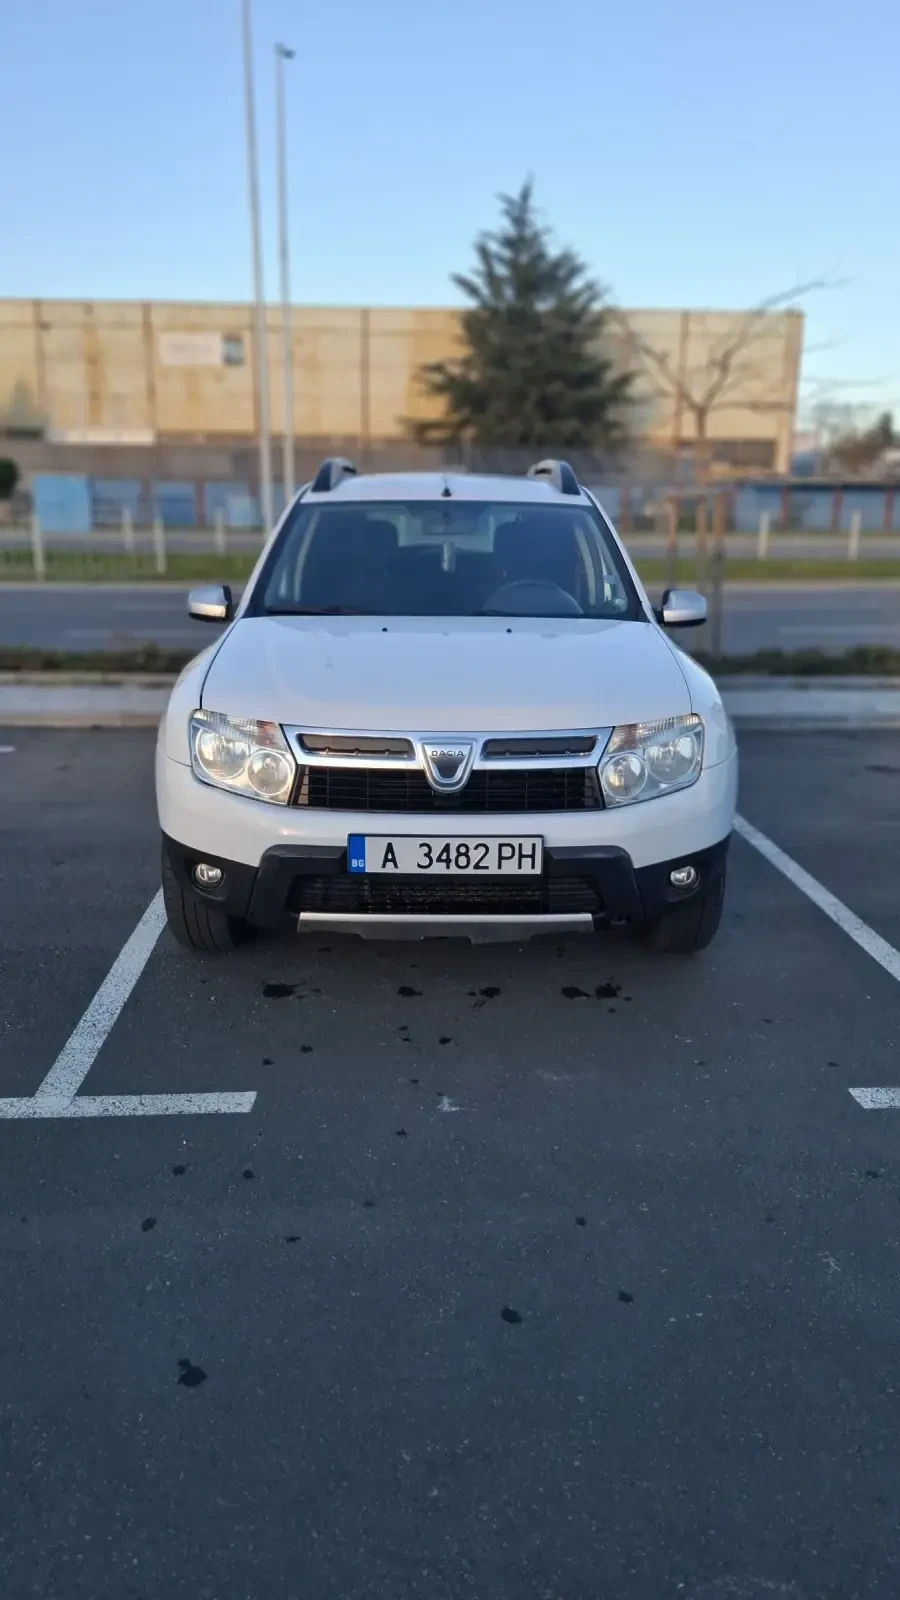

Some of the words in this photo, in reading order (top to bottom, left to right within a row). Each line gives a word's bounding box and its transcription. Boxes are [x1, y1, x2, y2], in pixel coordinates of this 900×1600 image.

[351, 859, 364, 868] BG
[381, 842, 399, 869] A
[416, 843, 490, 870] 3482
[497, 843, 536, 870] PH
